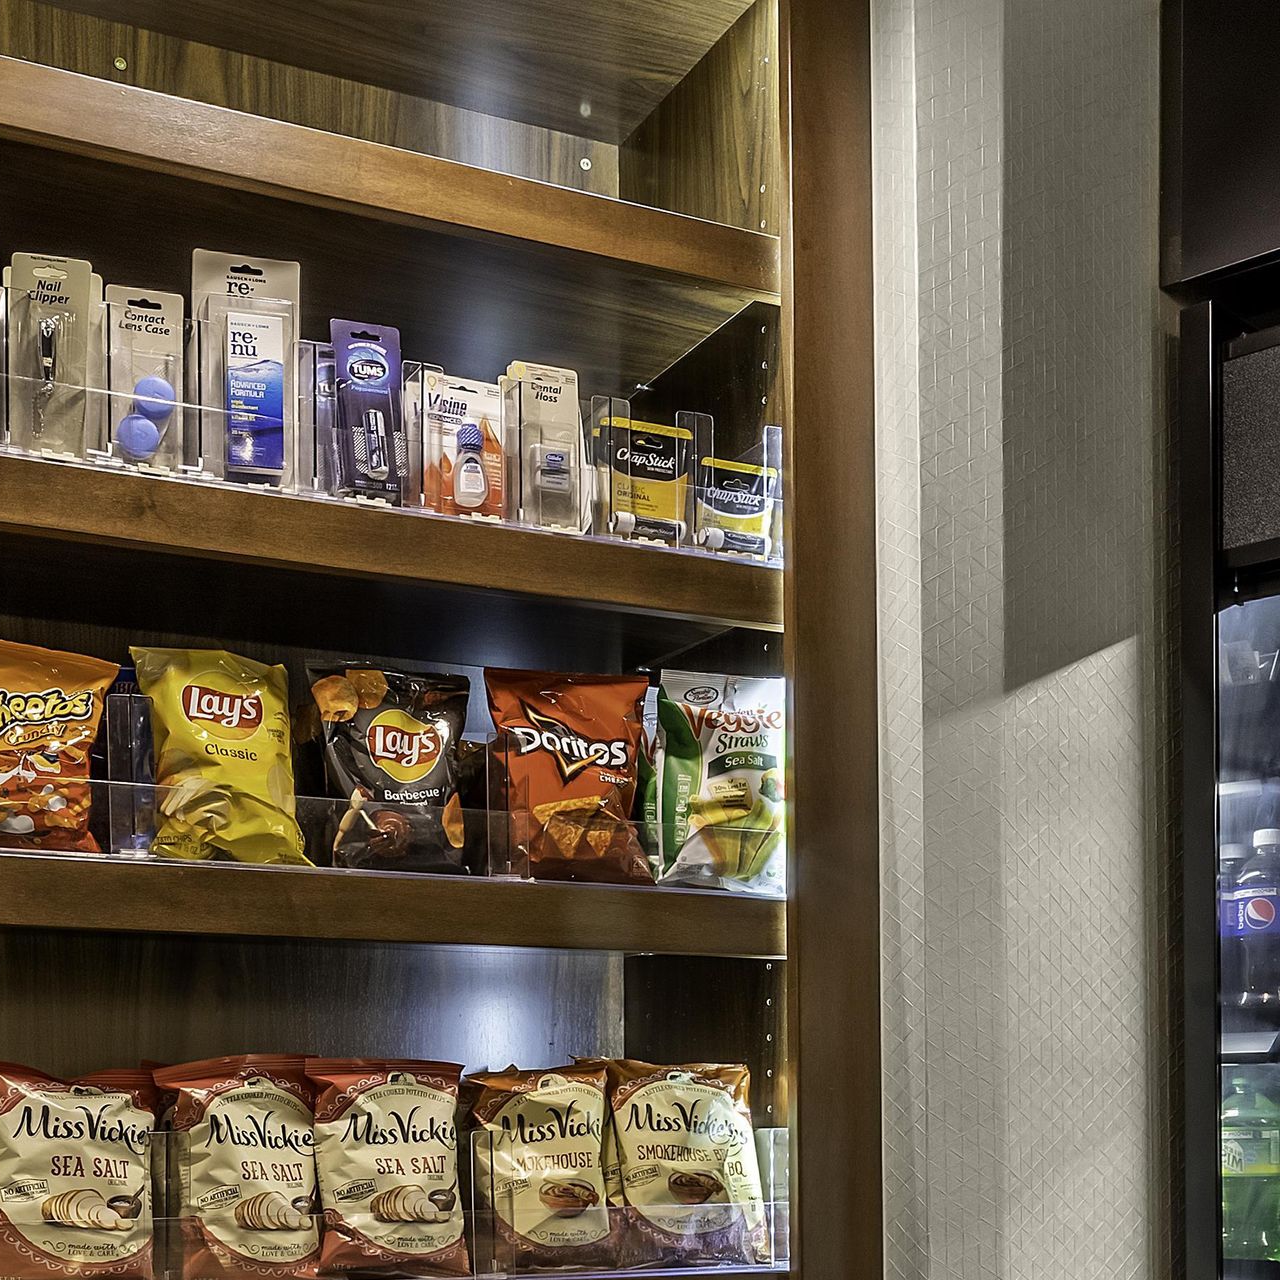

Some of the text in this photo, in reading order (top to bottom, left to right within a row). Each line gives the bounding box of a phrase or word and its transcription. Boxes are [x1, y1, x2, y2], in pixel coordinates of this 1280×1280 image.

[36, 279, 61, 292] Nail
[123, 309, 166, 325] Contact
[118, 321, 170, 336] Lens Case
[352, 363, 384, 378] TUMS
[190, 686, 257, 728] Lay's
[205, 743, 258, 761] Classic
[375, 727, 436, 767] Lay's
[514, 727, 628, 766] Doritos
[715, 733, 769, 754] Straws
[724, 755, 764, 768] Sea Salt
[384, 787, 440, 801] Barbecue
[51, 1155, 130, 1179] SEA SALT
[241, 1160, 304, 1182] SEA SALT
[375, 1155, 446, 1175] SEA SALT
